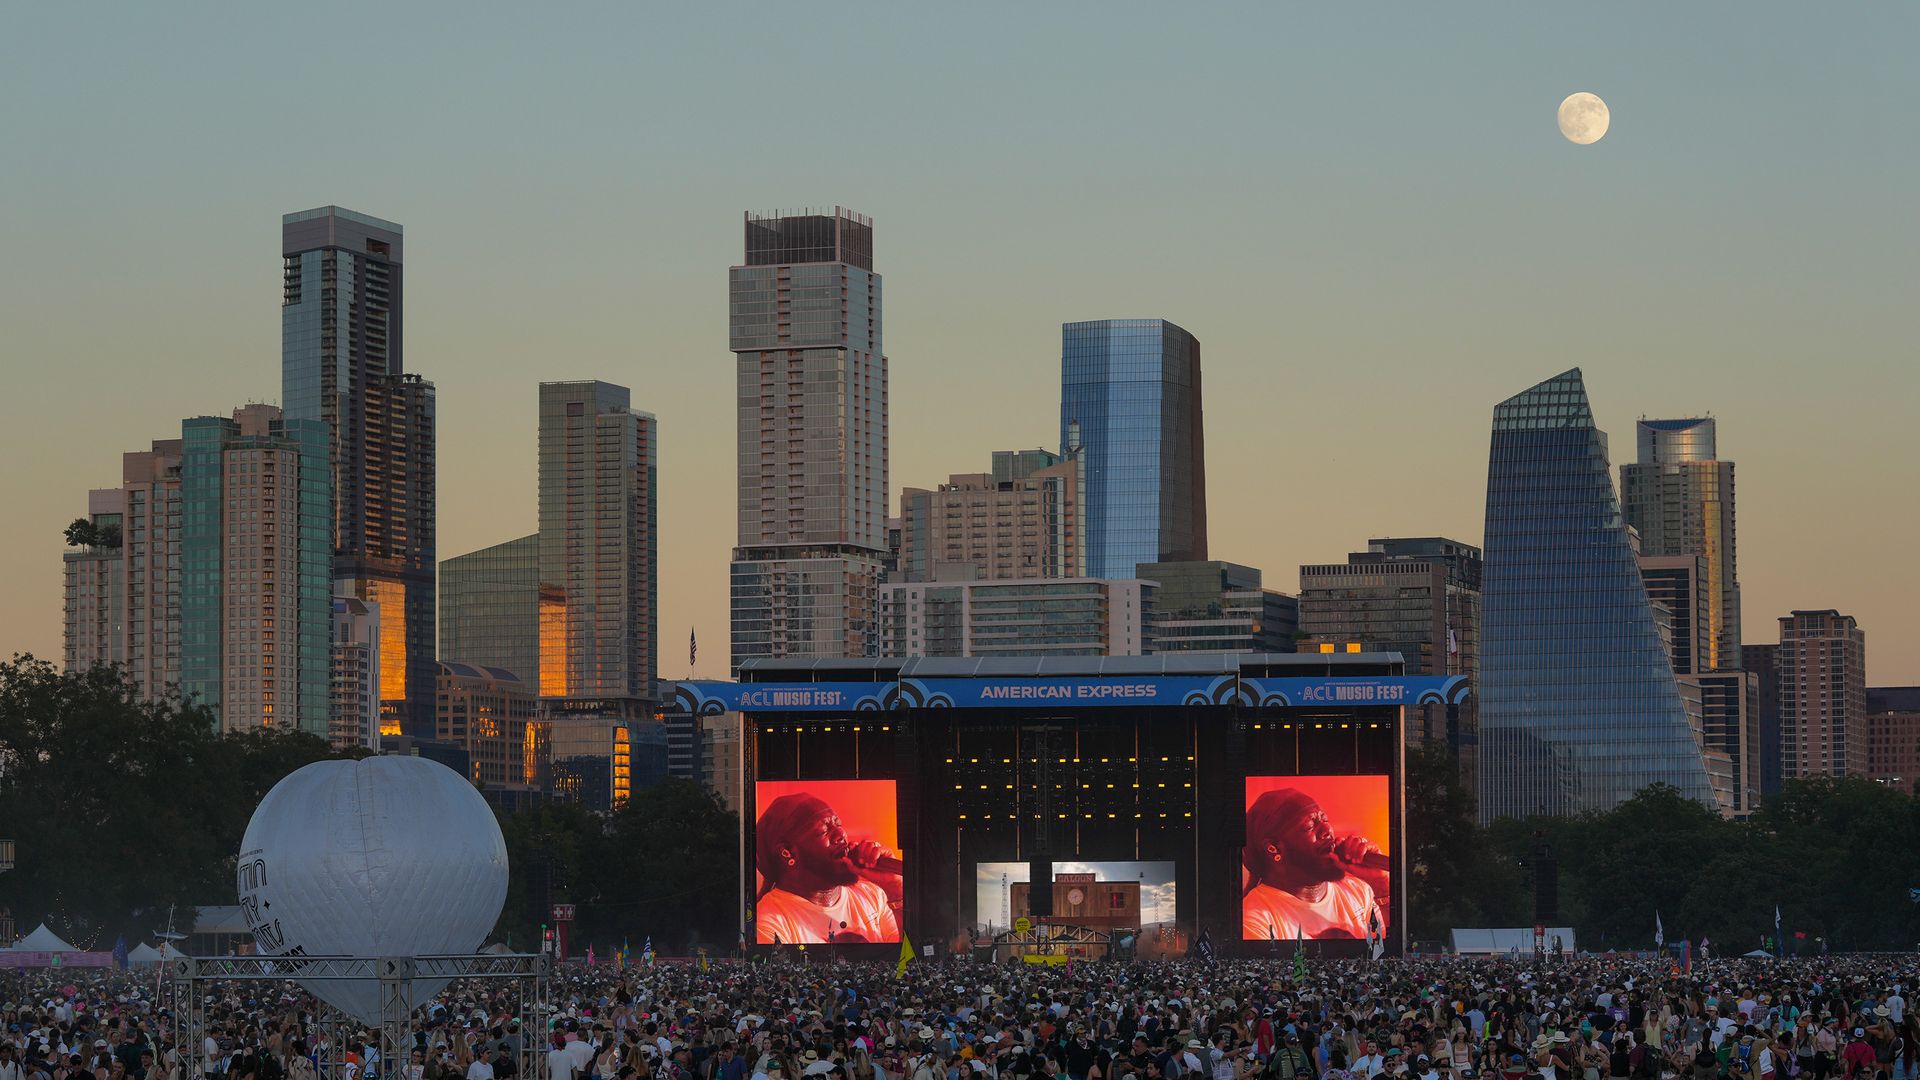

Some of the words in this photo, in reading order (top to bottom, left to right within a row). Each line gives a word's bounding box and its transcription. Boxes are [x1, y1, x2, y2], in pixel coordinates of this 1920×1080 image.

[740, 691, 772, 706] ACL
[773, 691, 811, 706] MUSIC
[814, 690, 841, 706] FEST
[980, 685, 1071, 698] AMERICAN
[1077, 684, 1157, 698] EXPRESS
[1303, 686, 1334, 701] ACL
[1336, 686, 1374, 701] MUSIC
[1377, 685, 1404, 700] FEST
